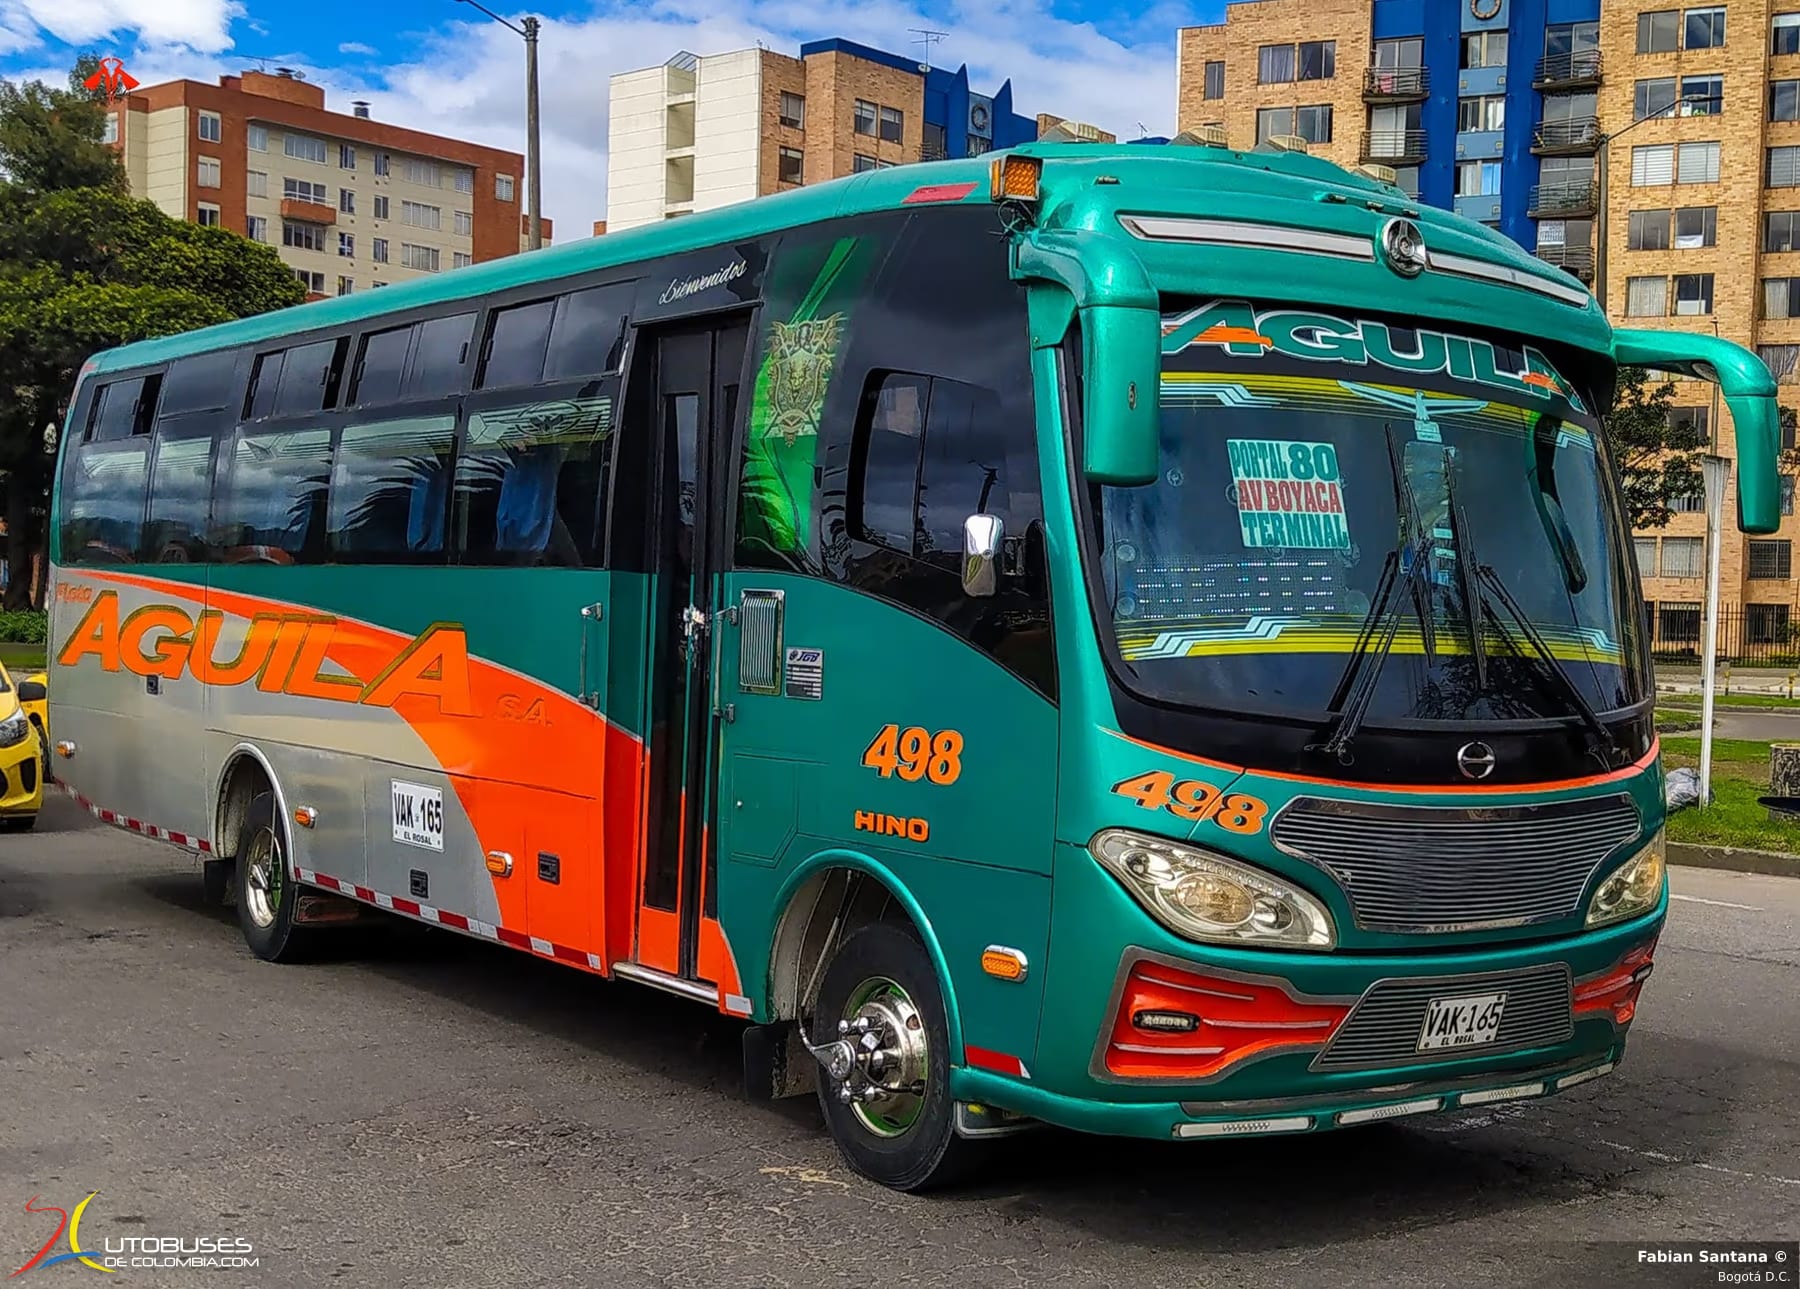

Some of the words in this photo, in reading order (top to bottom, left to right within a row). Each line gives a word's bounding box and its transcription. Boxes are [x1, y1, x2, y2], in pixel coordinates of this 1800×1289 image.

[1160, 299, 1589, 416] AGUILA
[1227, 441, 1289, 479] PORTAL
[1287, 443, 1339, 481] 80
[1238, 479, 1264, 511] AV
[1264, 480, 1343, 513] BOYACA
[1241, 511, 1349, 548] TERMINAL
[57, 589, 483, 719] AGUILA
[860, 724, 964, 785] 498
[1110, 770, 1269, 835] 498
[404, 831, 411, 840] EL
[412, 833, 432, 844] ROSAL
[854, 810, 929, 842] HINO
